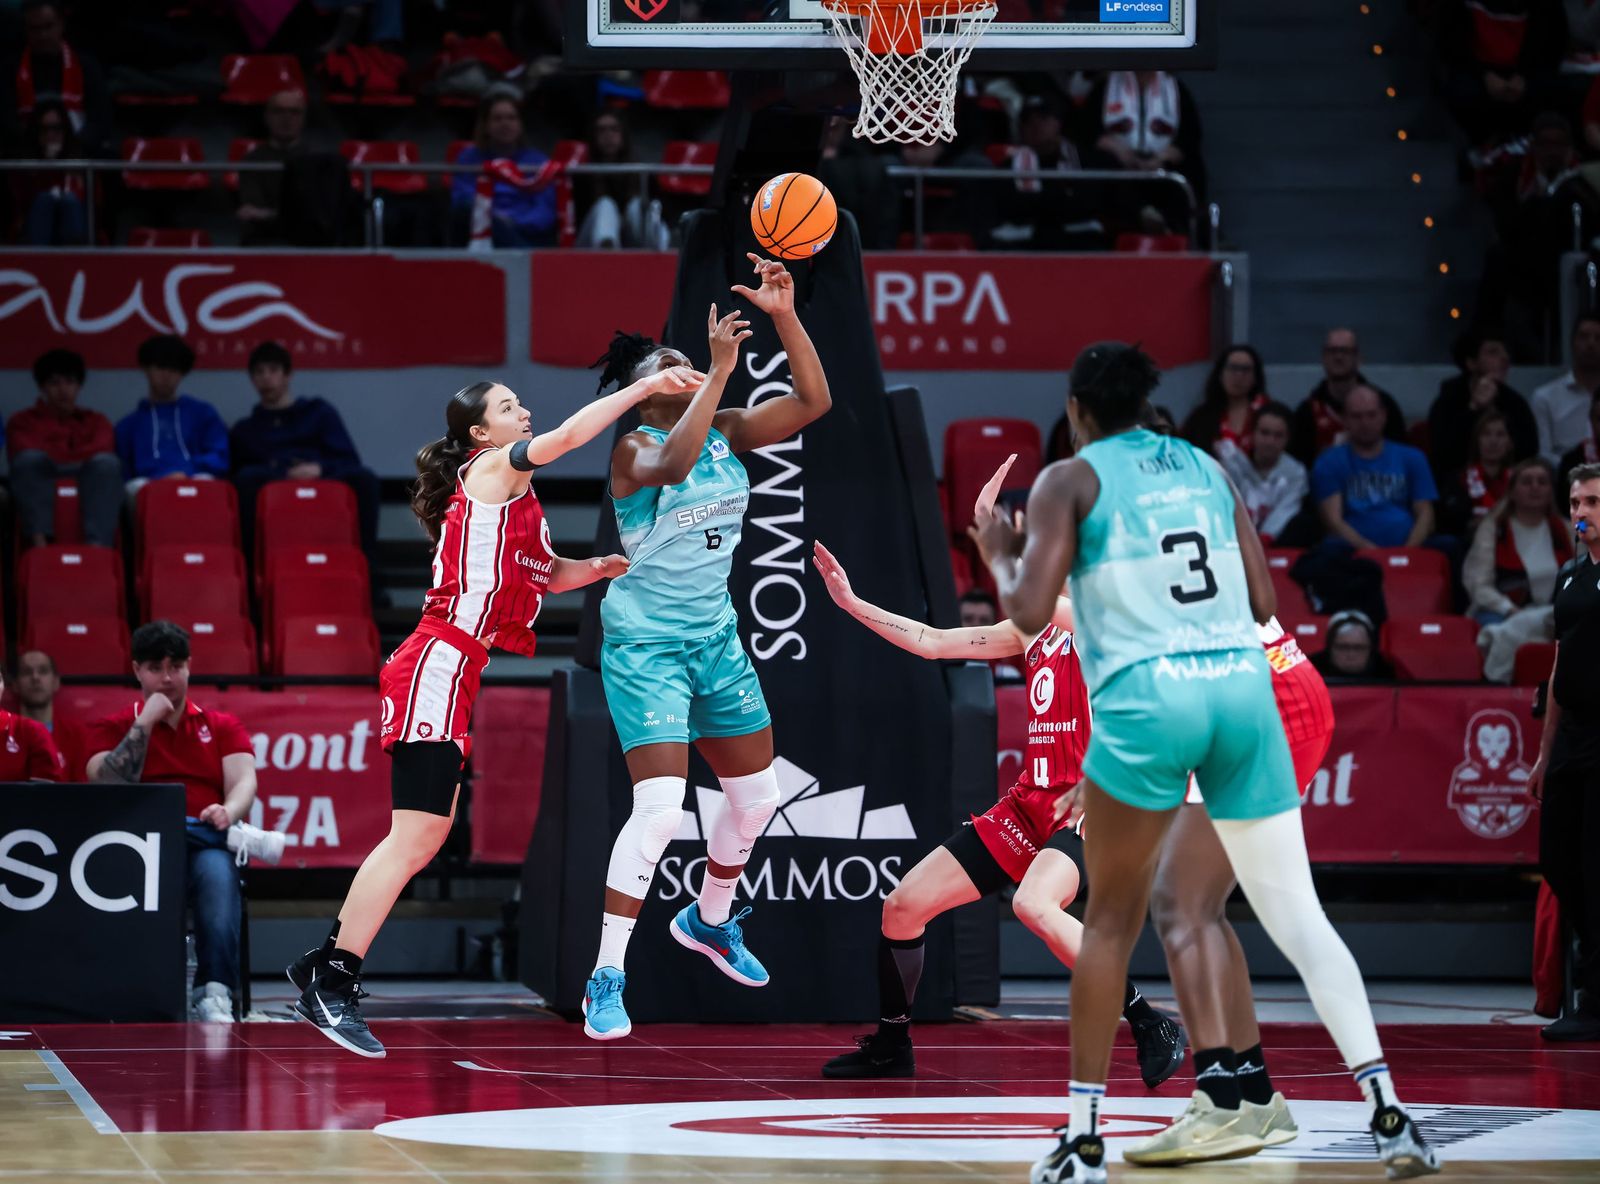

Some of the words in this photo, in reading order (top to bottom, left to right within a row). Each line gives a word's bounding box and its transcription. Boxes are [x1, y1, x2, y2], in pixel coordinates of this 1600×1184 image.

[1106, 2, 1121, 12] LF
[1122, 2, 1163, 12] endesa
[704, 527, 722, 550] 6
[1161, 531, 1218, 604] 3
[1034, 757, 1049, 788] 4
[999, 831, 1022, 856] HOTELES
